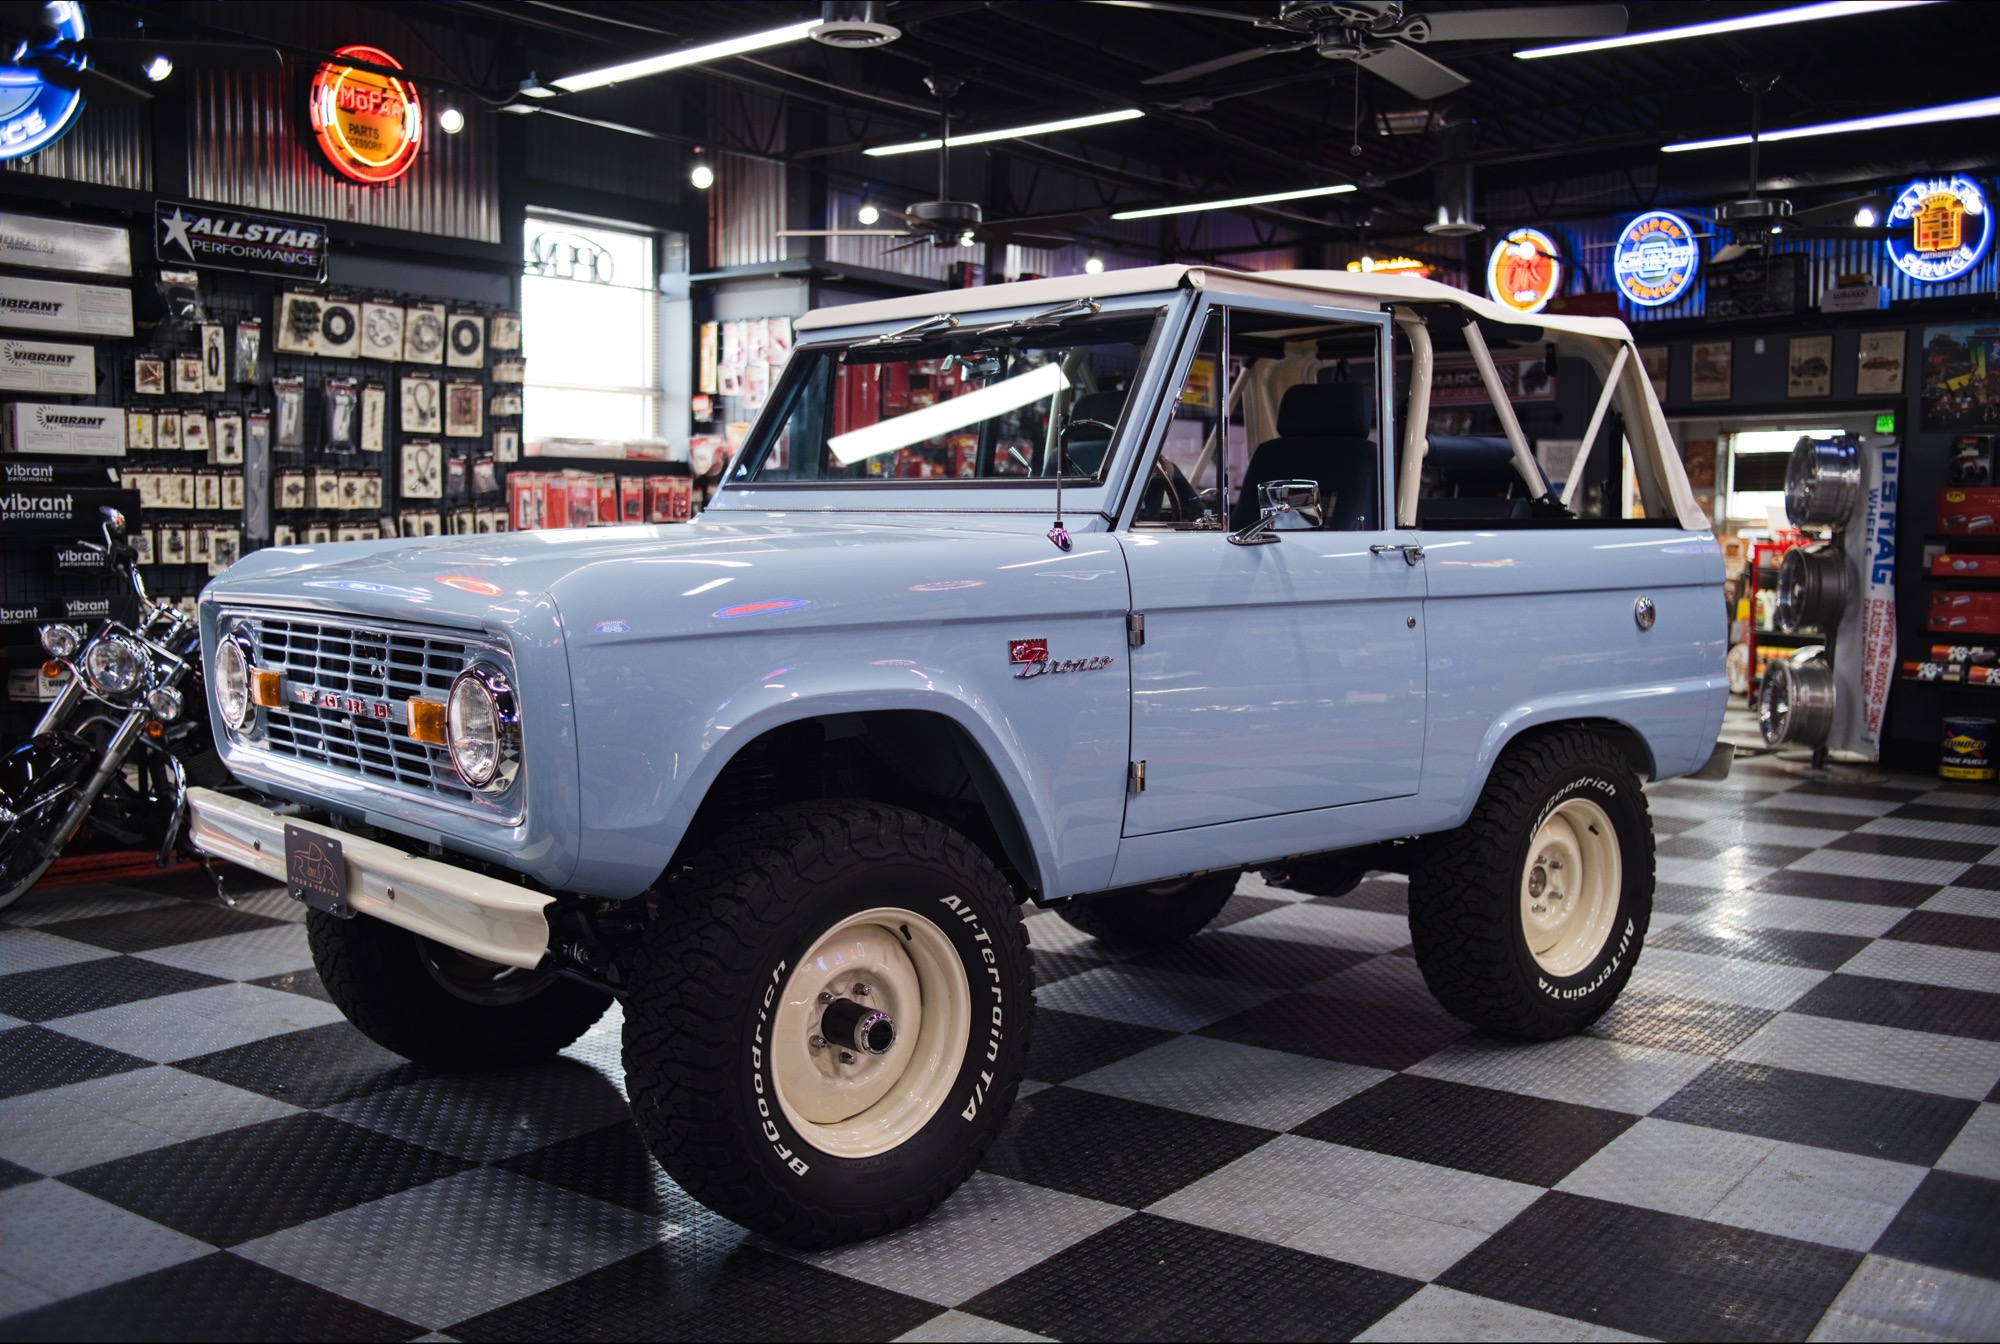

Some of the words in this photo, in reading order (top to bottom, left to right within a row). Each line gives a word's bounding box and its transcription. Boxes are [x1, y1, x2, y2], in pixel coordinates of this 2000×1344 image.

[348, 122, 380, 140] PARTS
[1894, 176, 1983, 219] CADILLA
[190, 217, 319, 249] ALLSTAR
[1629, 218, 1680, 242] SUPER
[6, 245, 55, 255] PERFORMANCE
[192, 239, 318, 266] PERFORMANCE
[1899, 242, 1974, 277] SERVICE
[1625, 272, 1684, 299] SERVICE
[9, 308, 59, 317] PERFORMANCE
[13, 351, 75, 364] VIBRANT
[29, 360, 71, 368] PERFORMANCE
[45, 414, 106, 427] VIBRANT
[5, 464, 54, 477] vibrant
[0, 493, 73, 511] vibrant
[2, 511, 73, 519] performance
[57, 550, 104, 562] vibran
[60, 560, 104, 568] performance
[66, 599, 110, 611] vibrant
[1013, 647, 1115, 680] Bronco
[299, 690, 392, 720] FORD
[1943, 738, 1987, 750] SUNOCO
[1562, 917, 1634, 1000] All-Terrain
[939, 895, 1004, 1063] All-Terrain
[1538, 976, 1561, 1000] T/A
[752, 960, 811, 1177] BFGoodrich
[961, 1069, 994, 1123] T/A
